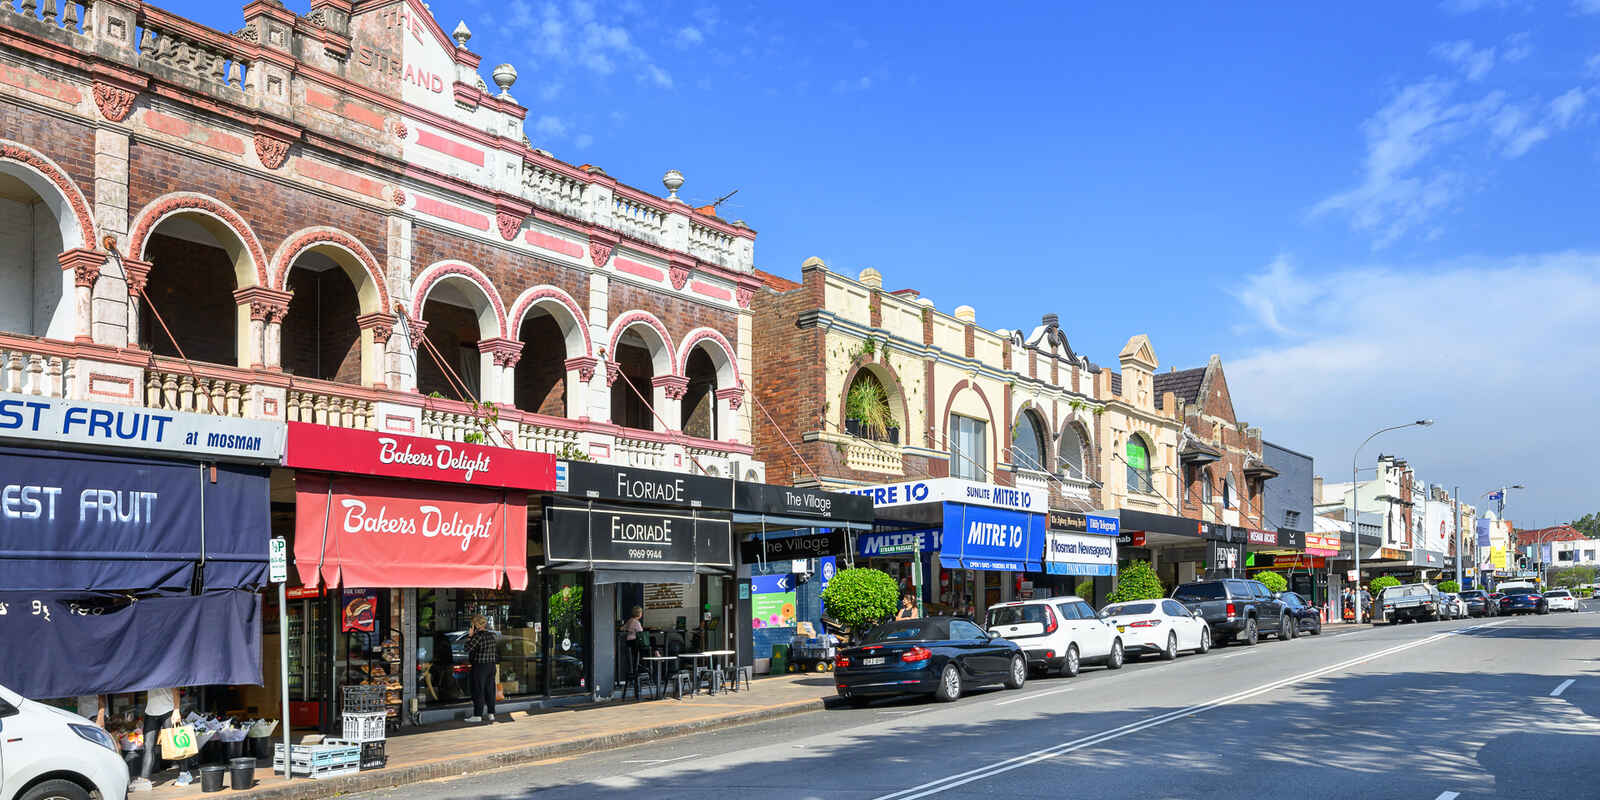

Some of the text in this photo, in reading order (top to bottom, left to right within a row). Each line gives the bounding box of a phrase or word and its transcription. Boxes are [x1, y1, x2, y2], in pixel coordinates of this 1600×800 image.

[384, 8, 425, 46] THE
[359, 44, 444, 94] STRAND
[63, 407, 173, 442] FRUIT
[186, 432, 198, 446] at
[207, 433, 261, 451] MOSMAN
[378, 437, 491, 482] Bakers Delight
[617, 472, 684, 502] FLORIADE
[904, 482, 929, 502] 10
[966, 486, 1031, 508] SUNLITE MITRE 10
[0, 484, 158, 523] EST FRUIT
[785, 491, 831, 512] The Village
[340, 498, 492, 552] Bakers Delight
[611, 515, 672, 542] FLORIADE
[967, 520, 1023, 549] MITRE 10
[785, 537, 830, 551] Village
[932, 530, 943, 549] 1
[1051, 539, 1112, 558] Mosman Newsagency
[628, 549, 662, 559] 9969 9944
